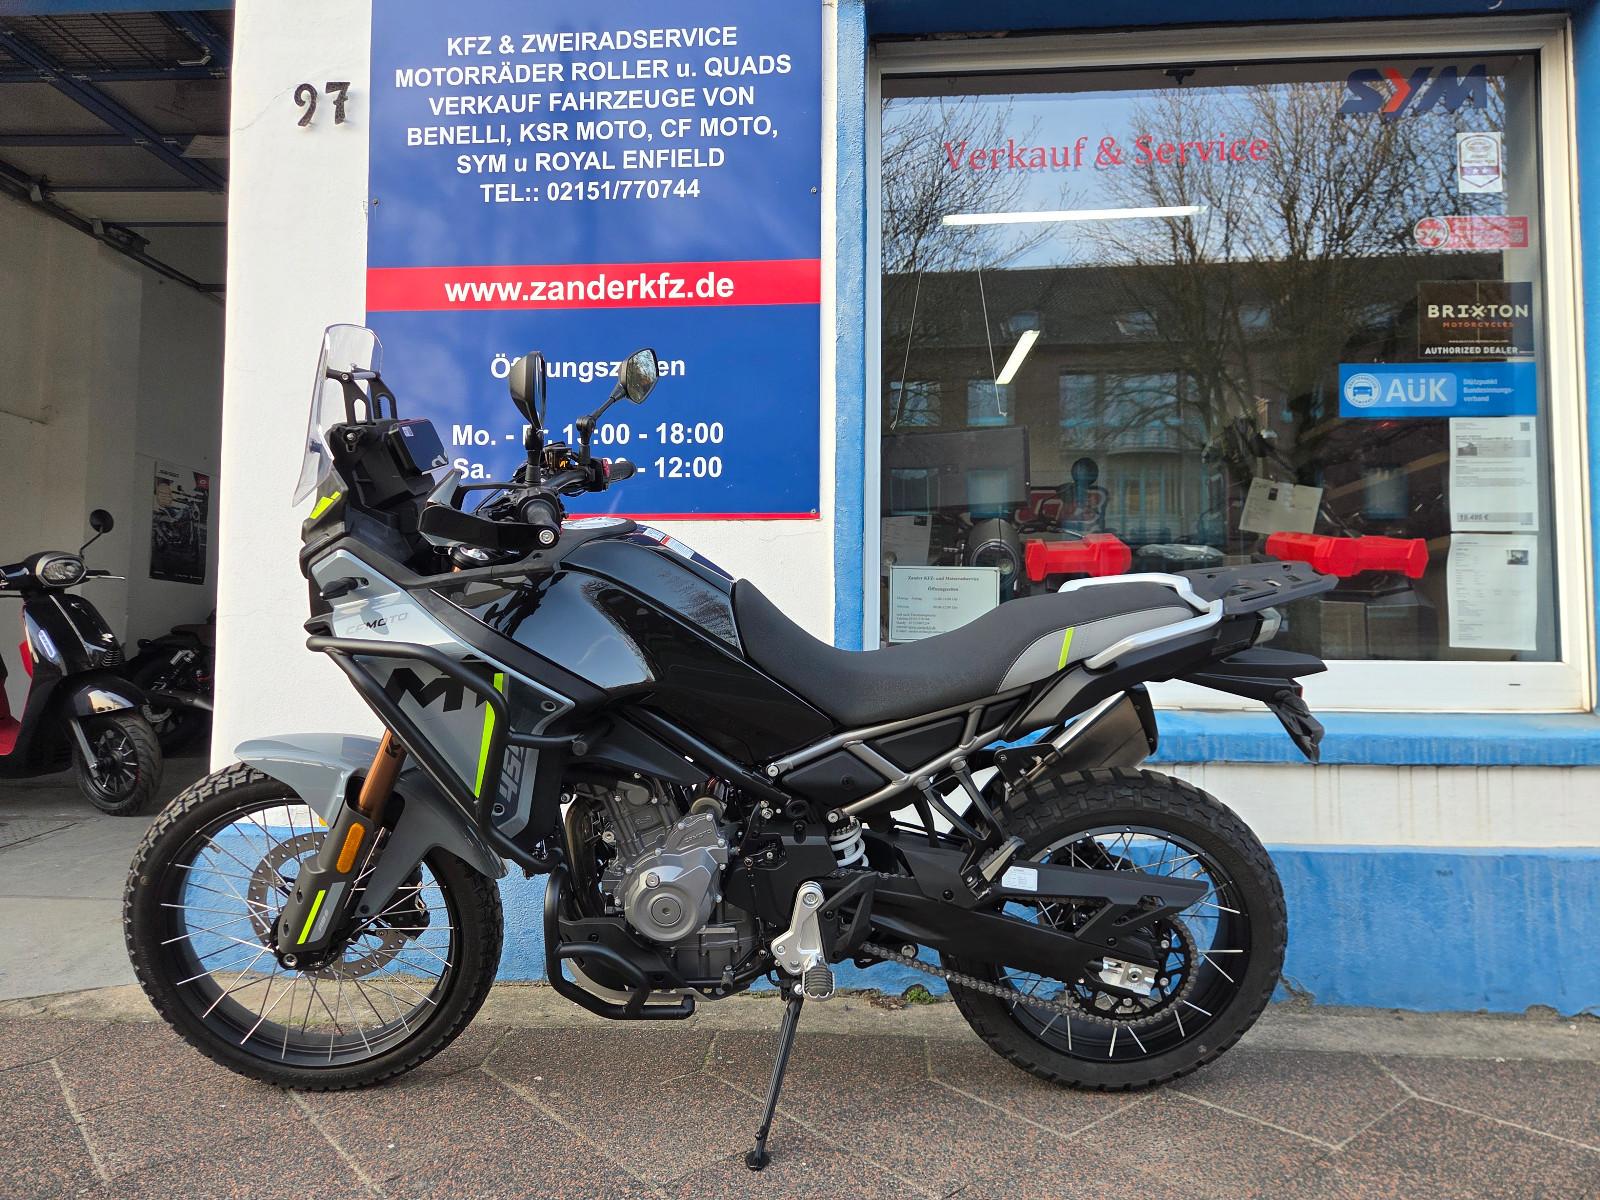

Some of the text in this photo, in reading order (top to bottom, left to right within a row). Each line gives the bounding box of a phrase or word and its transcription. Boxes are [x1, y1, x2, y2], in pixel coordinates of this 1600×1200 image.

[448, 27, 737, 56] KFZ & ZWEIRADSERVICE
[396, 54, 791, 87] MOTORRÄDER ROLLER u. QUADS
[294, 81, 350, 127] 97
[429, 86, 753, 115] VERKAUF FAHRZEUGE VON
[1340, 63, 1488, 118] SYM
[408, 116, 777, 145] BENELLI, KSR MOTO, CF MOTO,
[457, 148, 724, 173] SYM u ROYAL ENFIELD
[944, 132, 1270, 171] Verkauf & Service
[480, 179, 700, 202] TEL:: 02151/770744
[445, 272, 733, 301] www.zanderkfz.de
[1427, 304, 1529, 319] BRIXTON
[1425, 346, 1519, 354] AUTHORIZED DEALER
[1386, 377, 1448, 402] AÜK
[453, 425, 496, 445] Mo.
[562, 423, 630, 444] 1:00
[657, 423, 723, 444] 18:00
[453, 456, 492, 479] Sa.
[655, 457, 721, 477] 12:00
